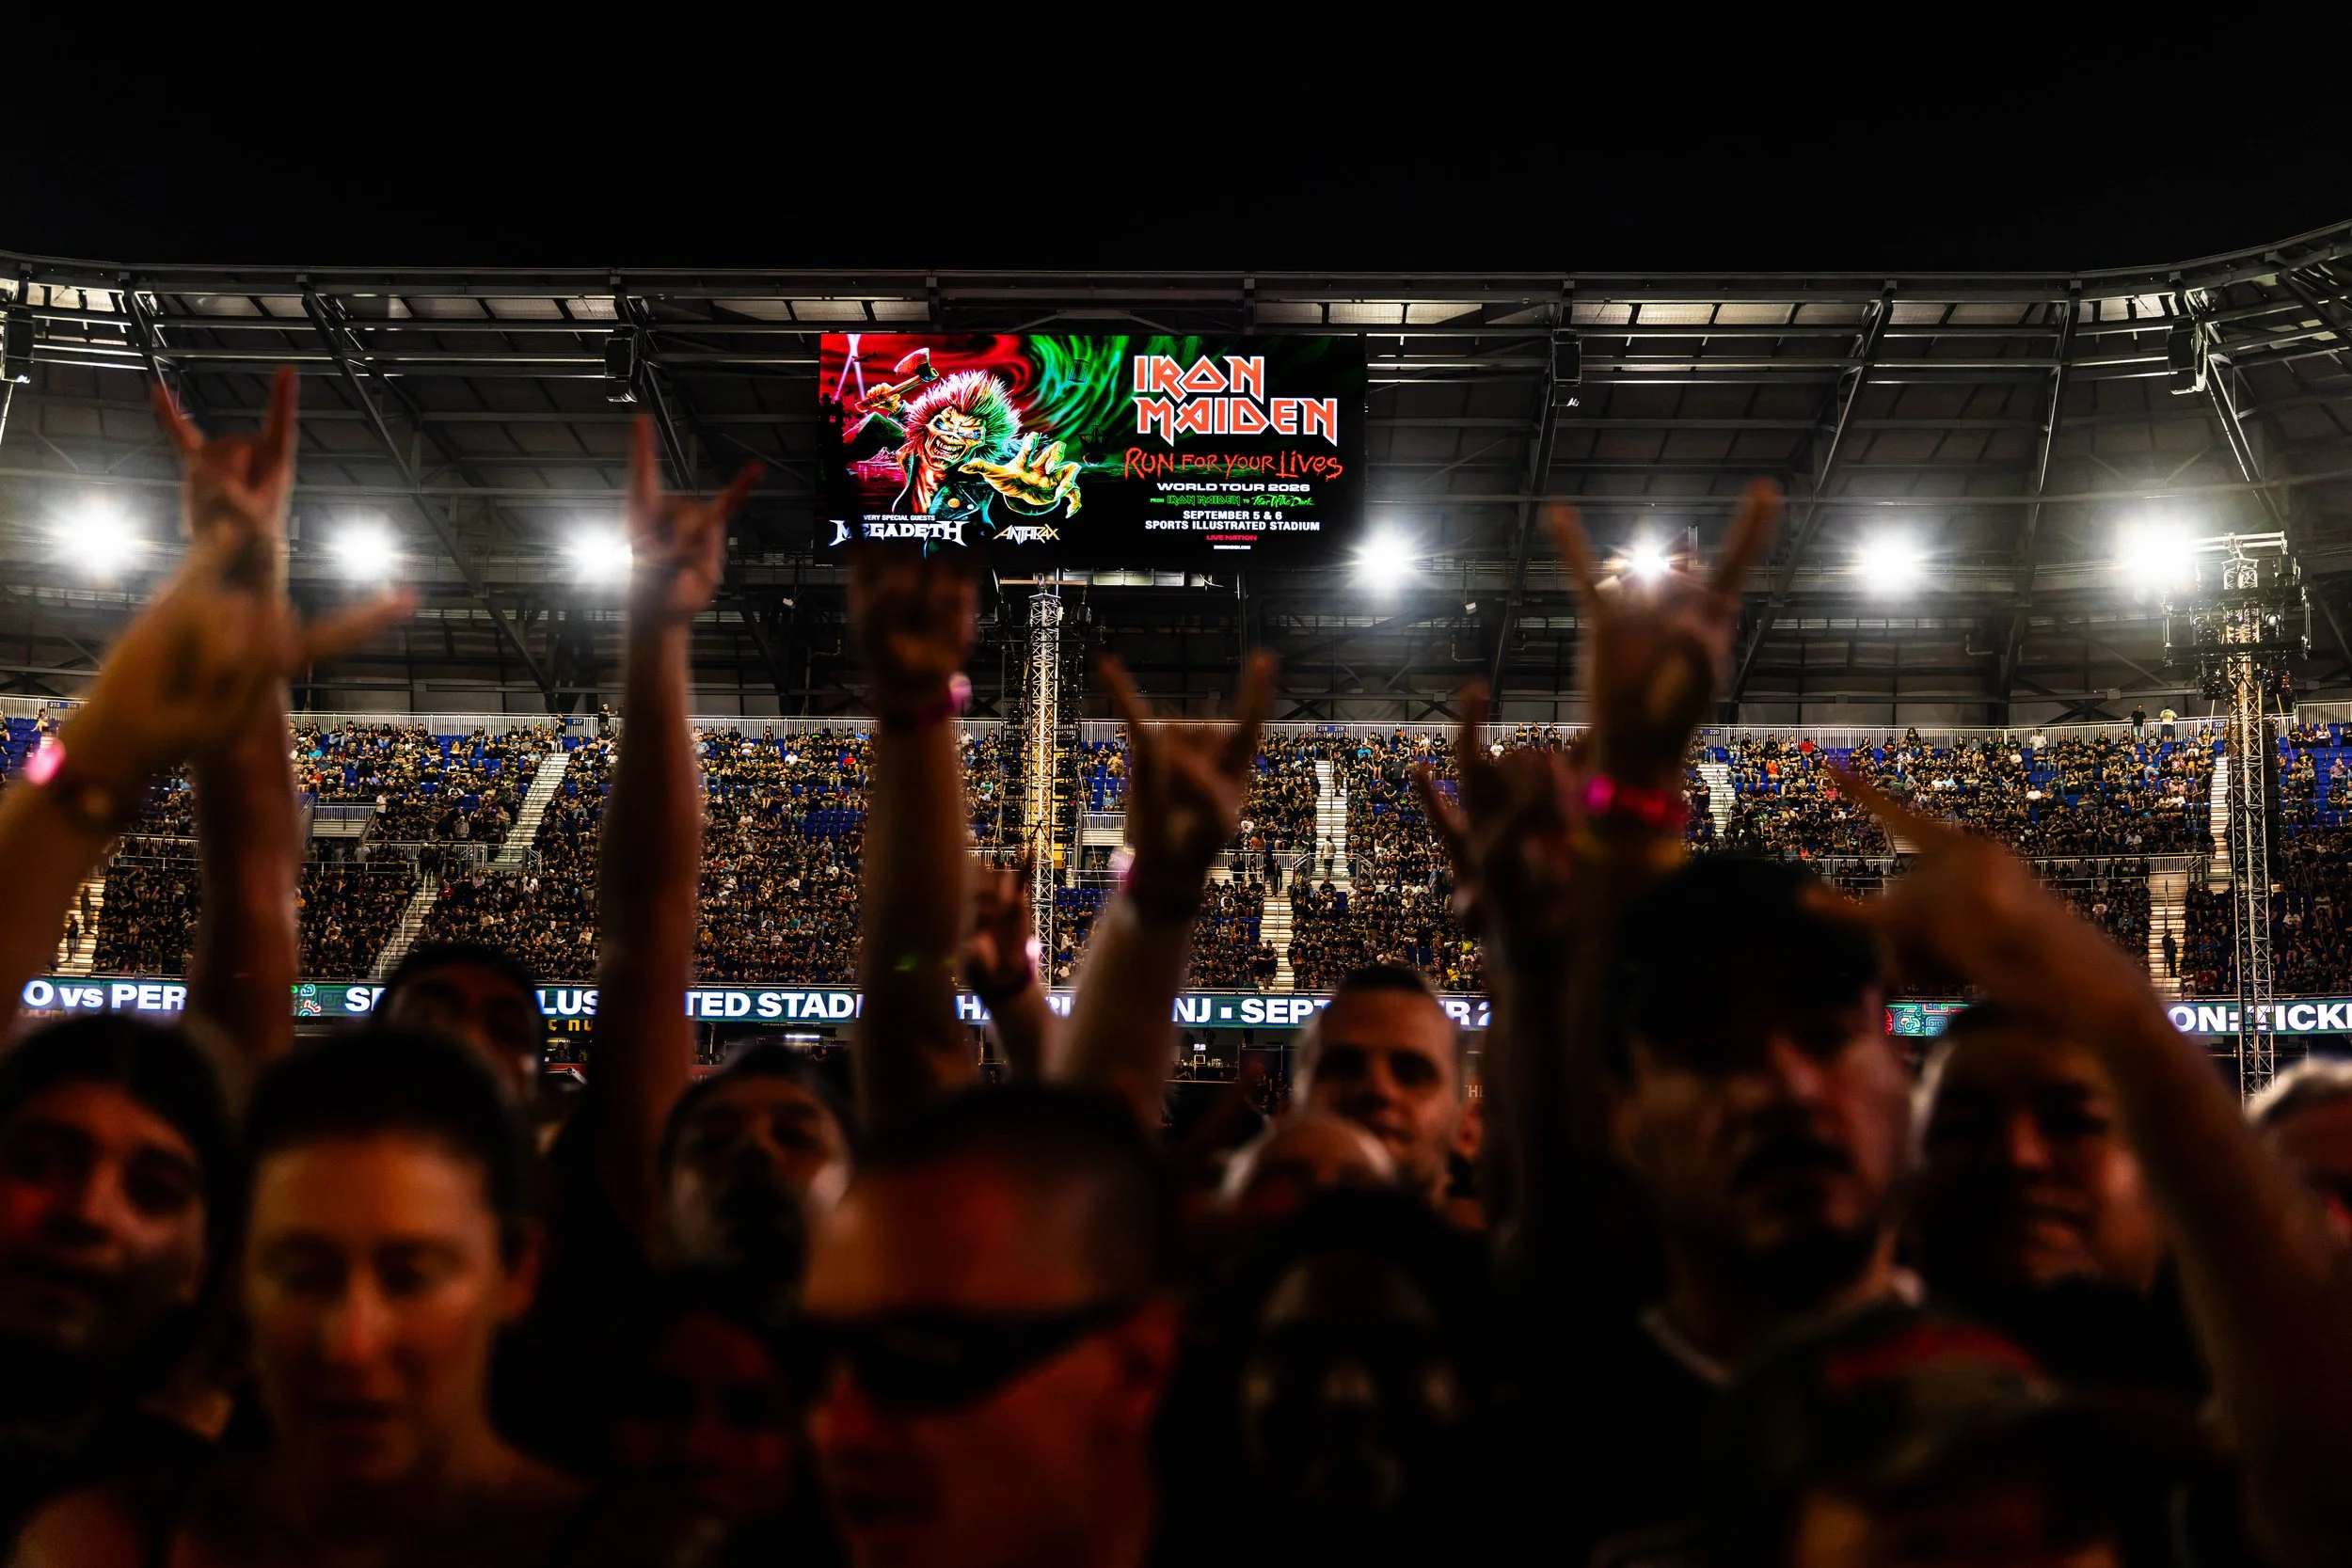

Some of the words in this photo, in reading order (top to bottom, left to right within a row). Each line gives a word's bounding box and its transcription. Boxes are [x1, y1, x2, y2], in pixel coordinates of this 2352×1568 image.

[1134, 355, 1264, 404] IRON
[1132, 396, 1338, 447] MAIDEN
[1124, 447, 1174, 480] RUN
[1182, 454, 1222, 472] FOR
[1223, 453, 1276, 480] YOUR
[1156, 483, 1217, 491] WORLD
[1219, 483, 1265, 492] TOUR
[1267, 483, 1311, 492] 2026
[1167, 495, 1195, 506] IRON
[1197, 495, 1241, 506] MAIDEN
[1183, 510, 1250, 520] SEPTEMBER
[1252, 511, 1261, 520] 5
[1263, 511, 1272, 520] &
[1275, 511, 1282, 520] 6
[993, 523, 1060, 545] ANTHRAX
[1145, 520, 1189, 531] SPORTS
[1192, 520, 1266, 531] ILLUSTRATED
[1269, 521, 1320, 531] STADIUM
[59, 988, 103, 1007] vs
